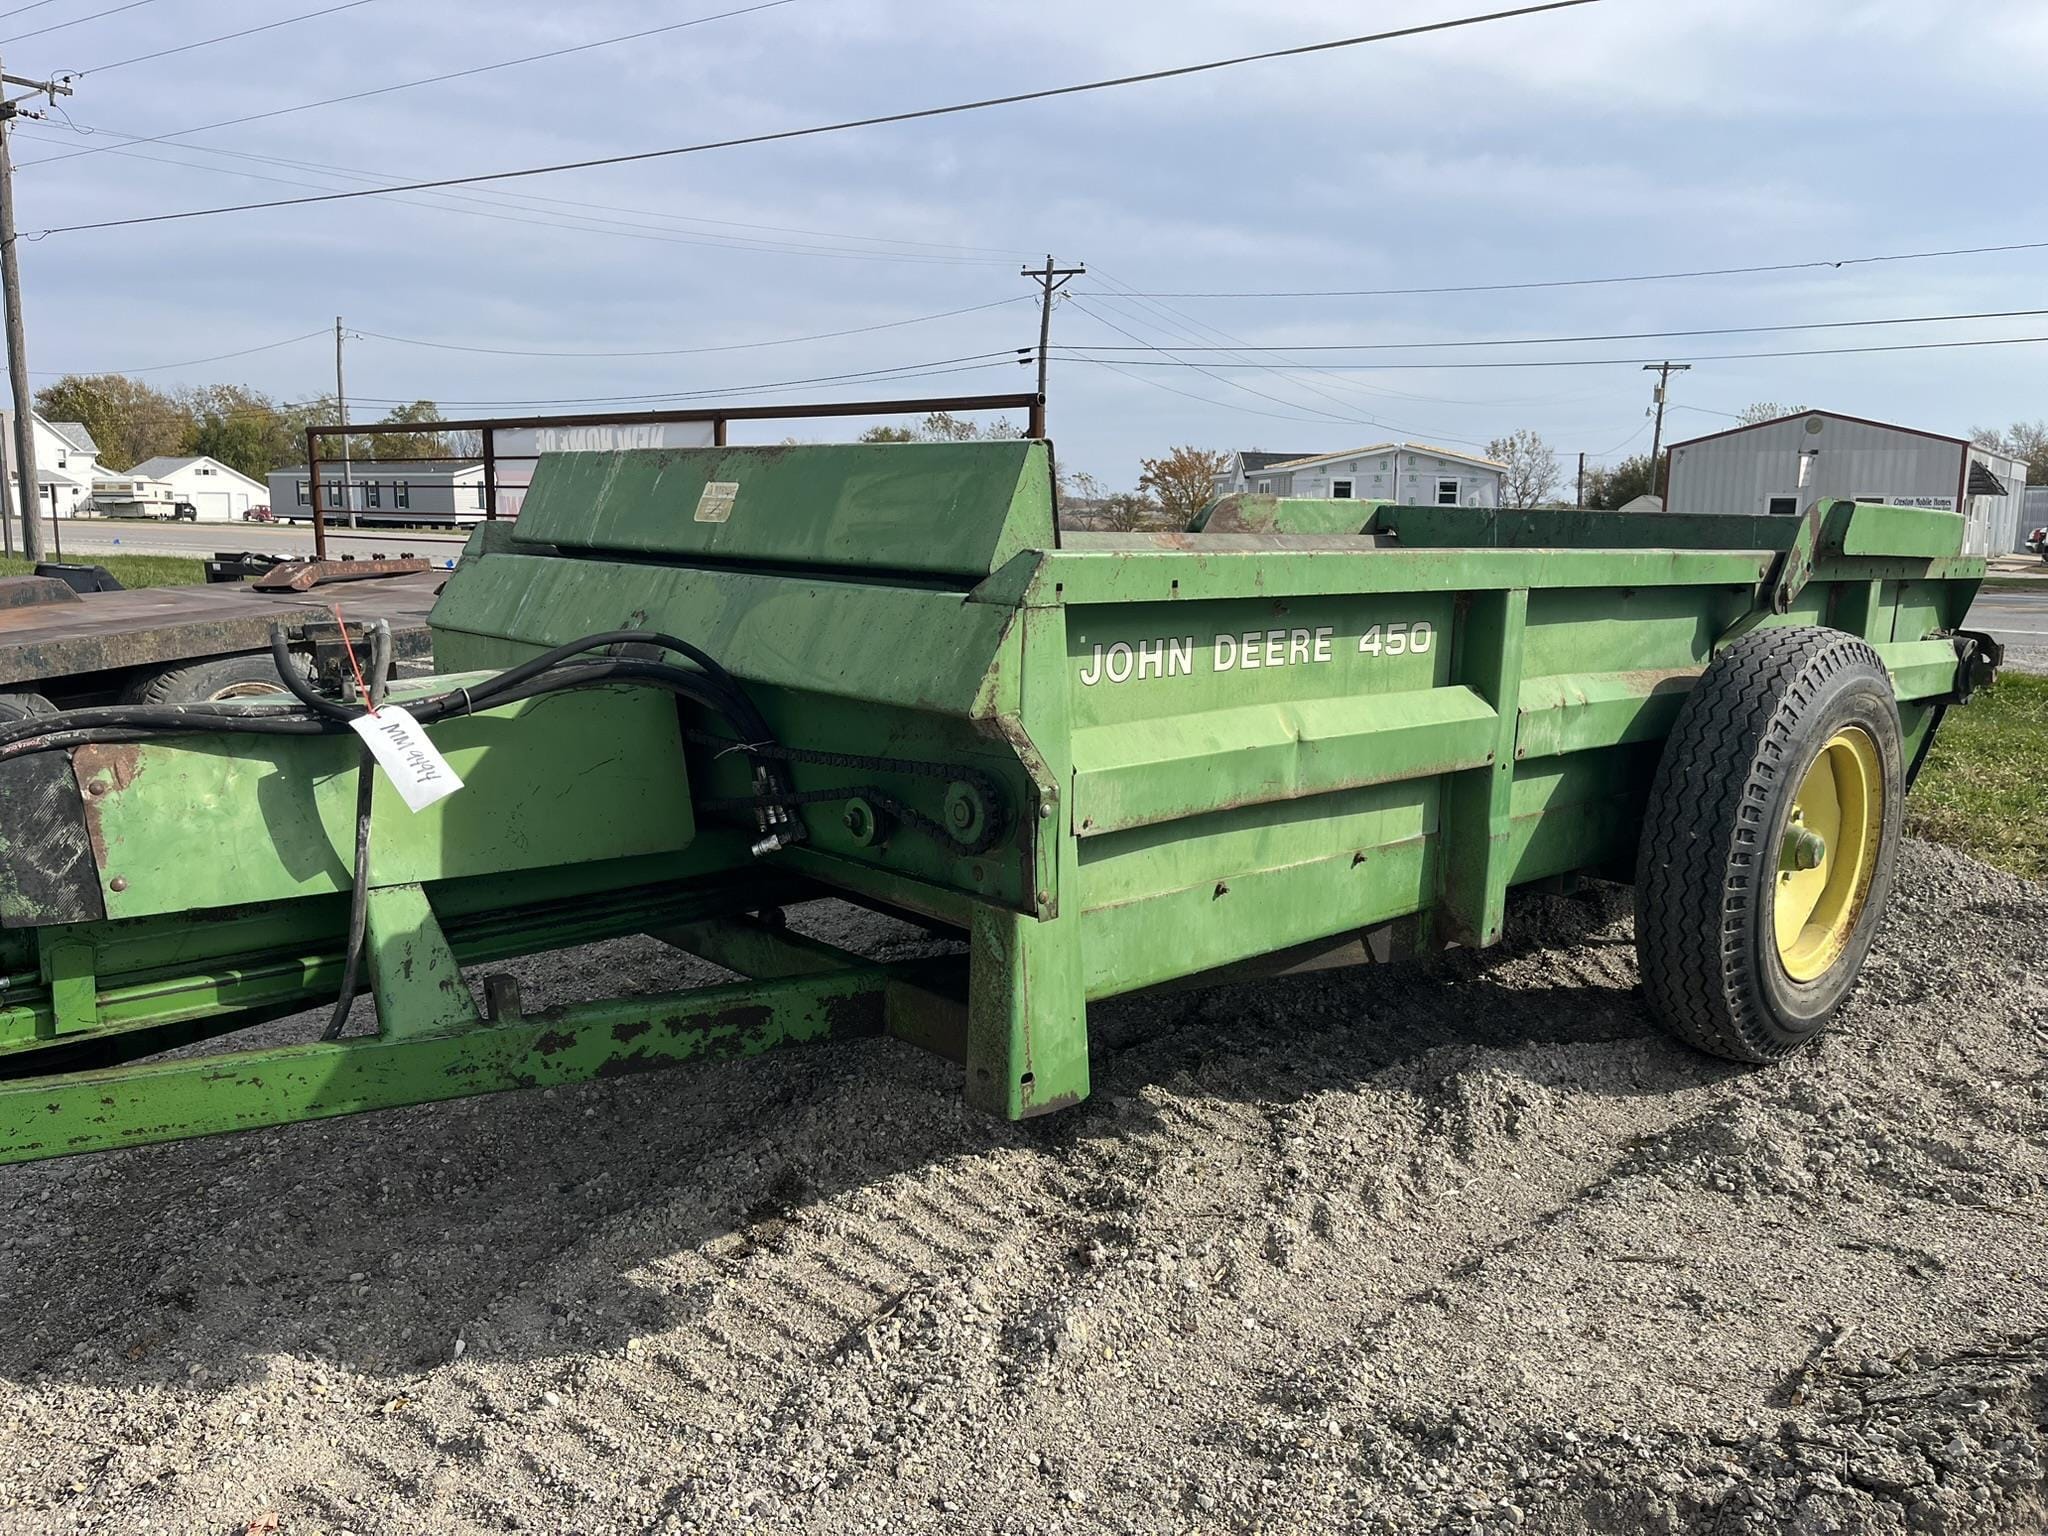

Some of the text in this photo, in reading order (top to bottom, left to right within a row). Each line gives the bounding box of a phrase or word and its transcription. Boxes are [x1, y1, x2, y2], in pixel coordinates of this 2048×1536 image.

[1915, 497, 1932, 506] Mobile
[1933, 497, 1952, 506] Homes
[1080, 621, 1433, 687] JOHN DEERE 450
